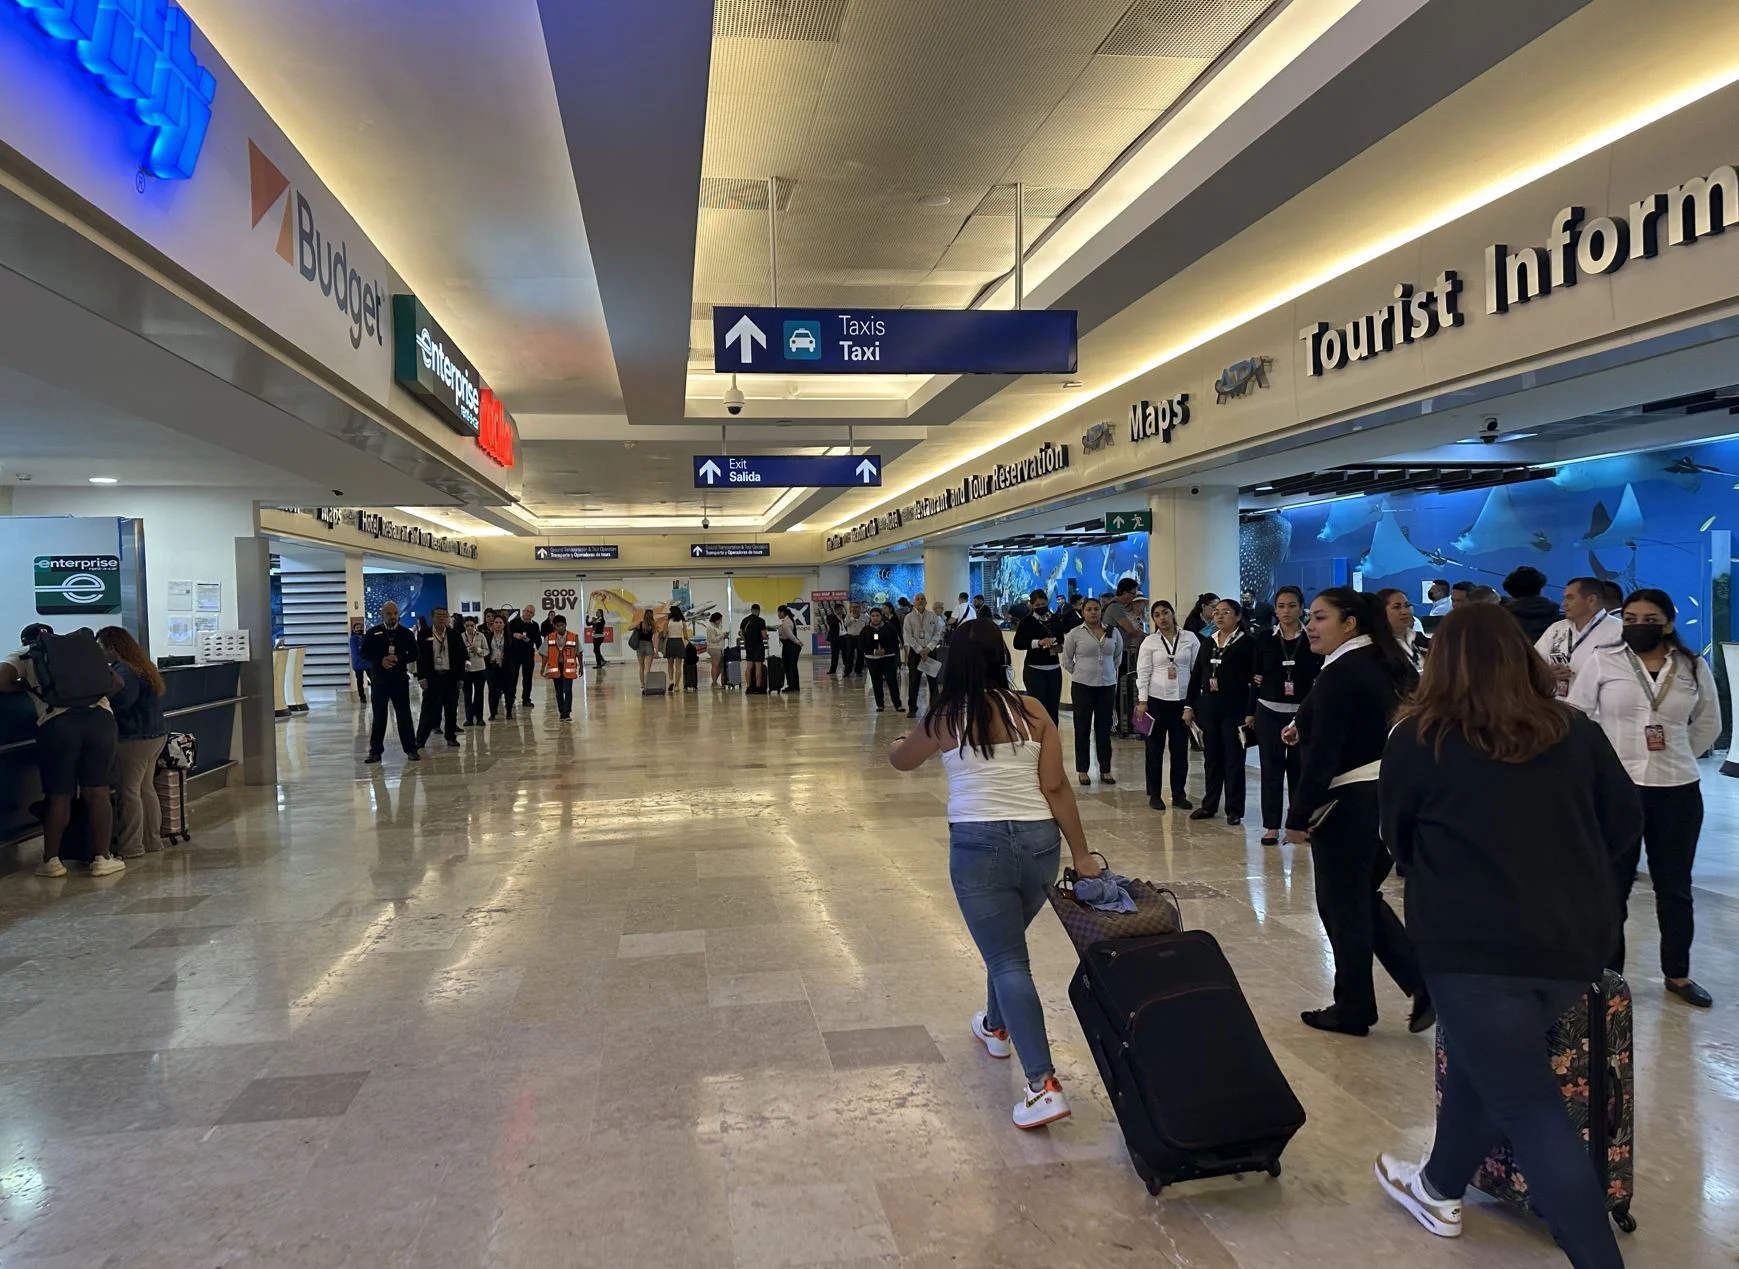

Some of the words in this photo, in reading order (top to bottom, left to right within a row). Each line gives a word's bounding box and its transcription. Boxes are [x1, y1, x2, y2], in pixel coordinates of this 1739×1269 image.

[297, 190, 383, 349] Budget
[839, 315, 885, 336] Taxis
[1300, 270, 1464, 376] Tourist
[839, 342, 880, 362] Taxi
[416, 328, 479, 414] enterprise
[1129, 394, 1190, 443] Maps
[729, 459, 747, 470] Exit
[729, 471, 761, 483] Salida
[914, 489, 949, 519] Restaurant
[951, 478, 969, 508] and
[968, 475, 992, 500] Tour
[991, 442, 1068, 491] Reservation
[38, 557, 118, 570] enterprise
[544, 589, 576, 597] GOOD
[541, 597, 578, 610] BUY
